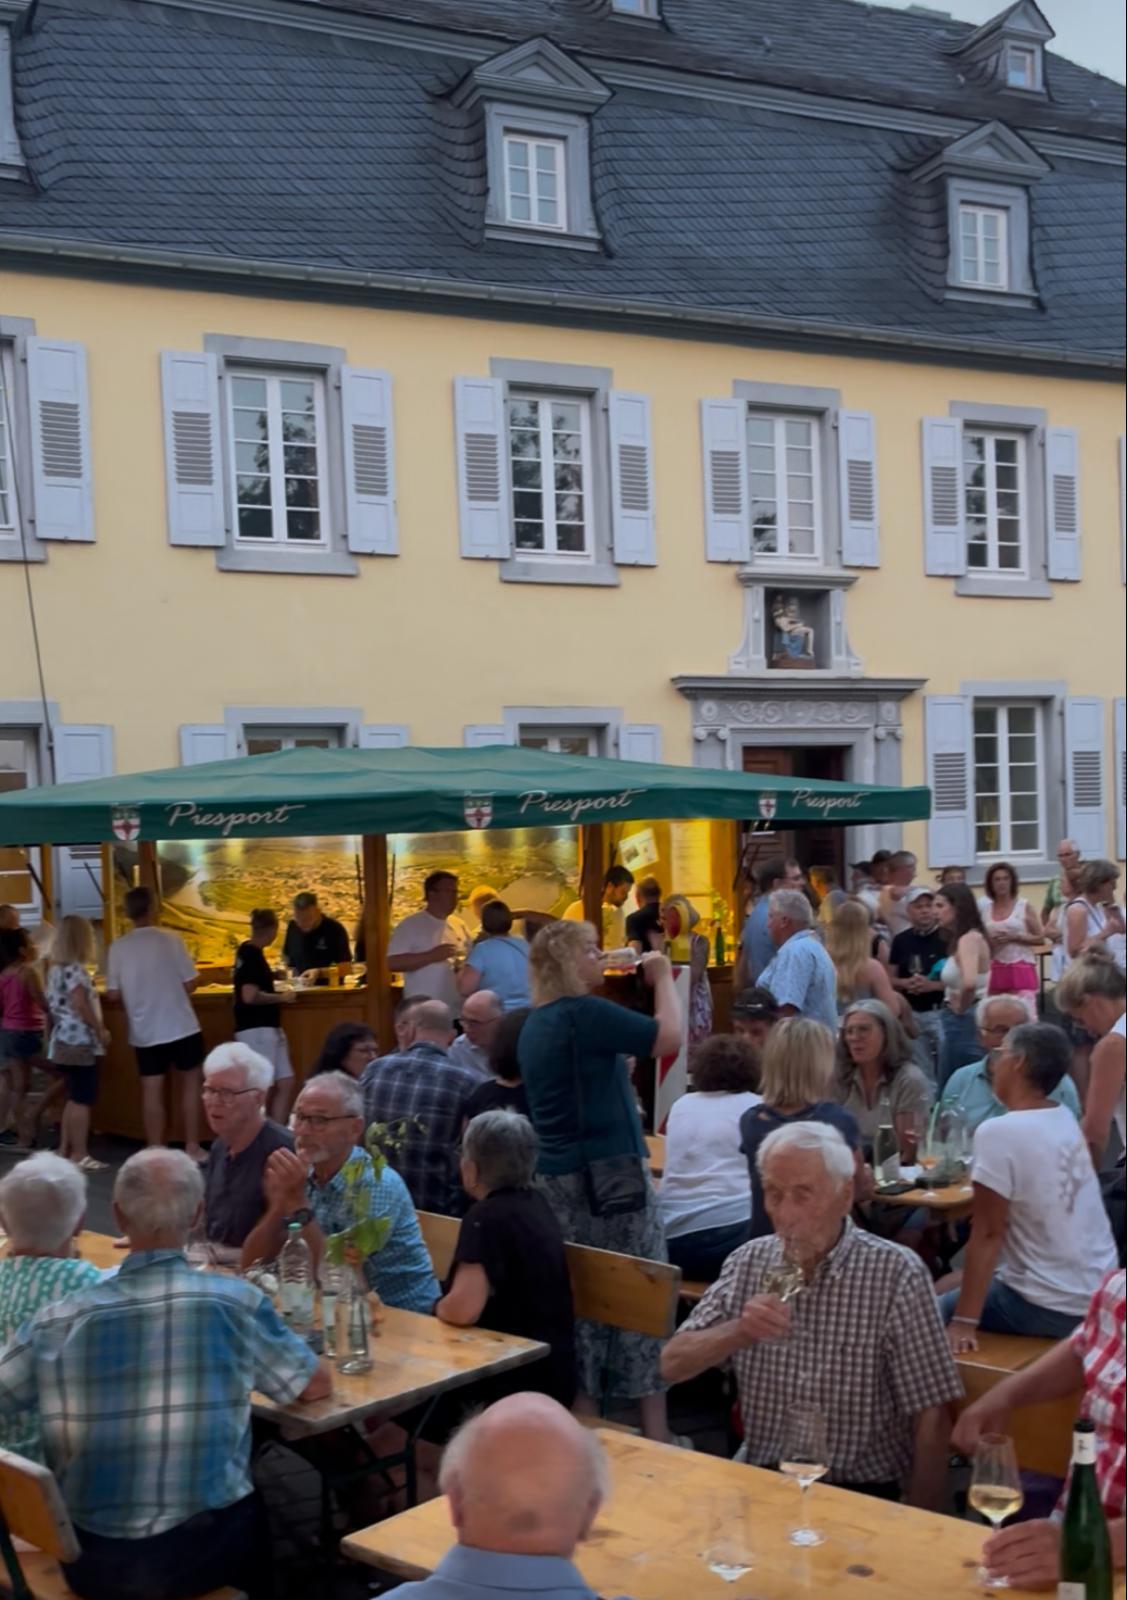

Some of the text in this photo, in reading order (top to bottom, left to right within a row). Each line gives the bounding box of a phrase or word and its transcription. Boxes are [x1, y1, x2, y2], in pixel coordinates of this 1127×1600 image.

[167, 800, 306, 836] Piesport
[519, 787, 647, 821] Piesport
[791, 786, 870, 817] Piesport
